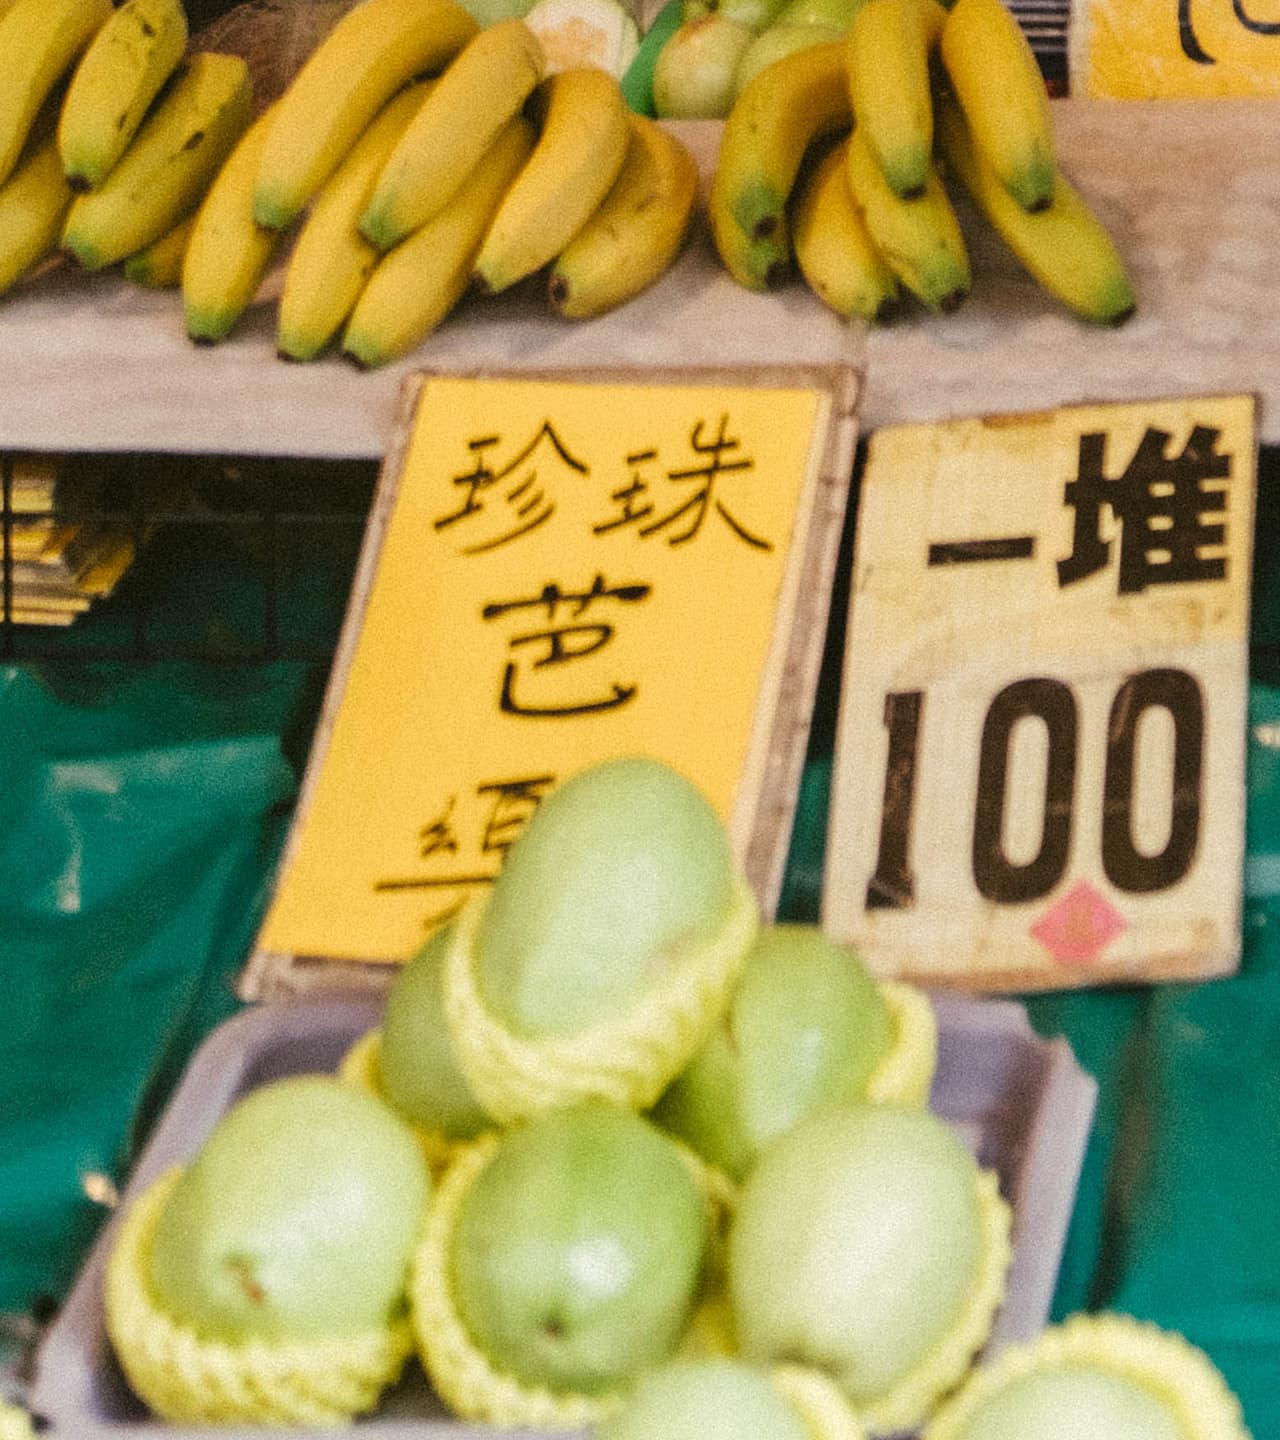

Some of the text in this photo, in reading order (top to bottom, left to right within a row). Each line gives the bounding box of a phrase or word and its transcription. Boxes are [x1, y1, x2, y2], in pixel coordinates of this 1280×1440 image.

[433, 413, 774, 556] 珍珠
[925, 422, 1232, 596] 一堆
[866, 666, 1206, 911] 100
